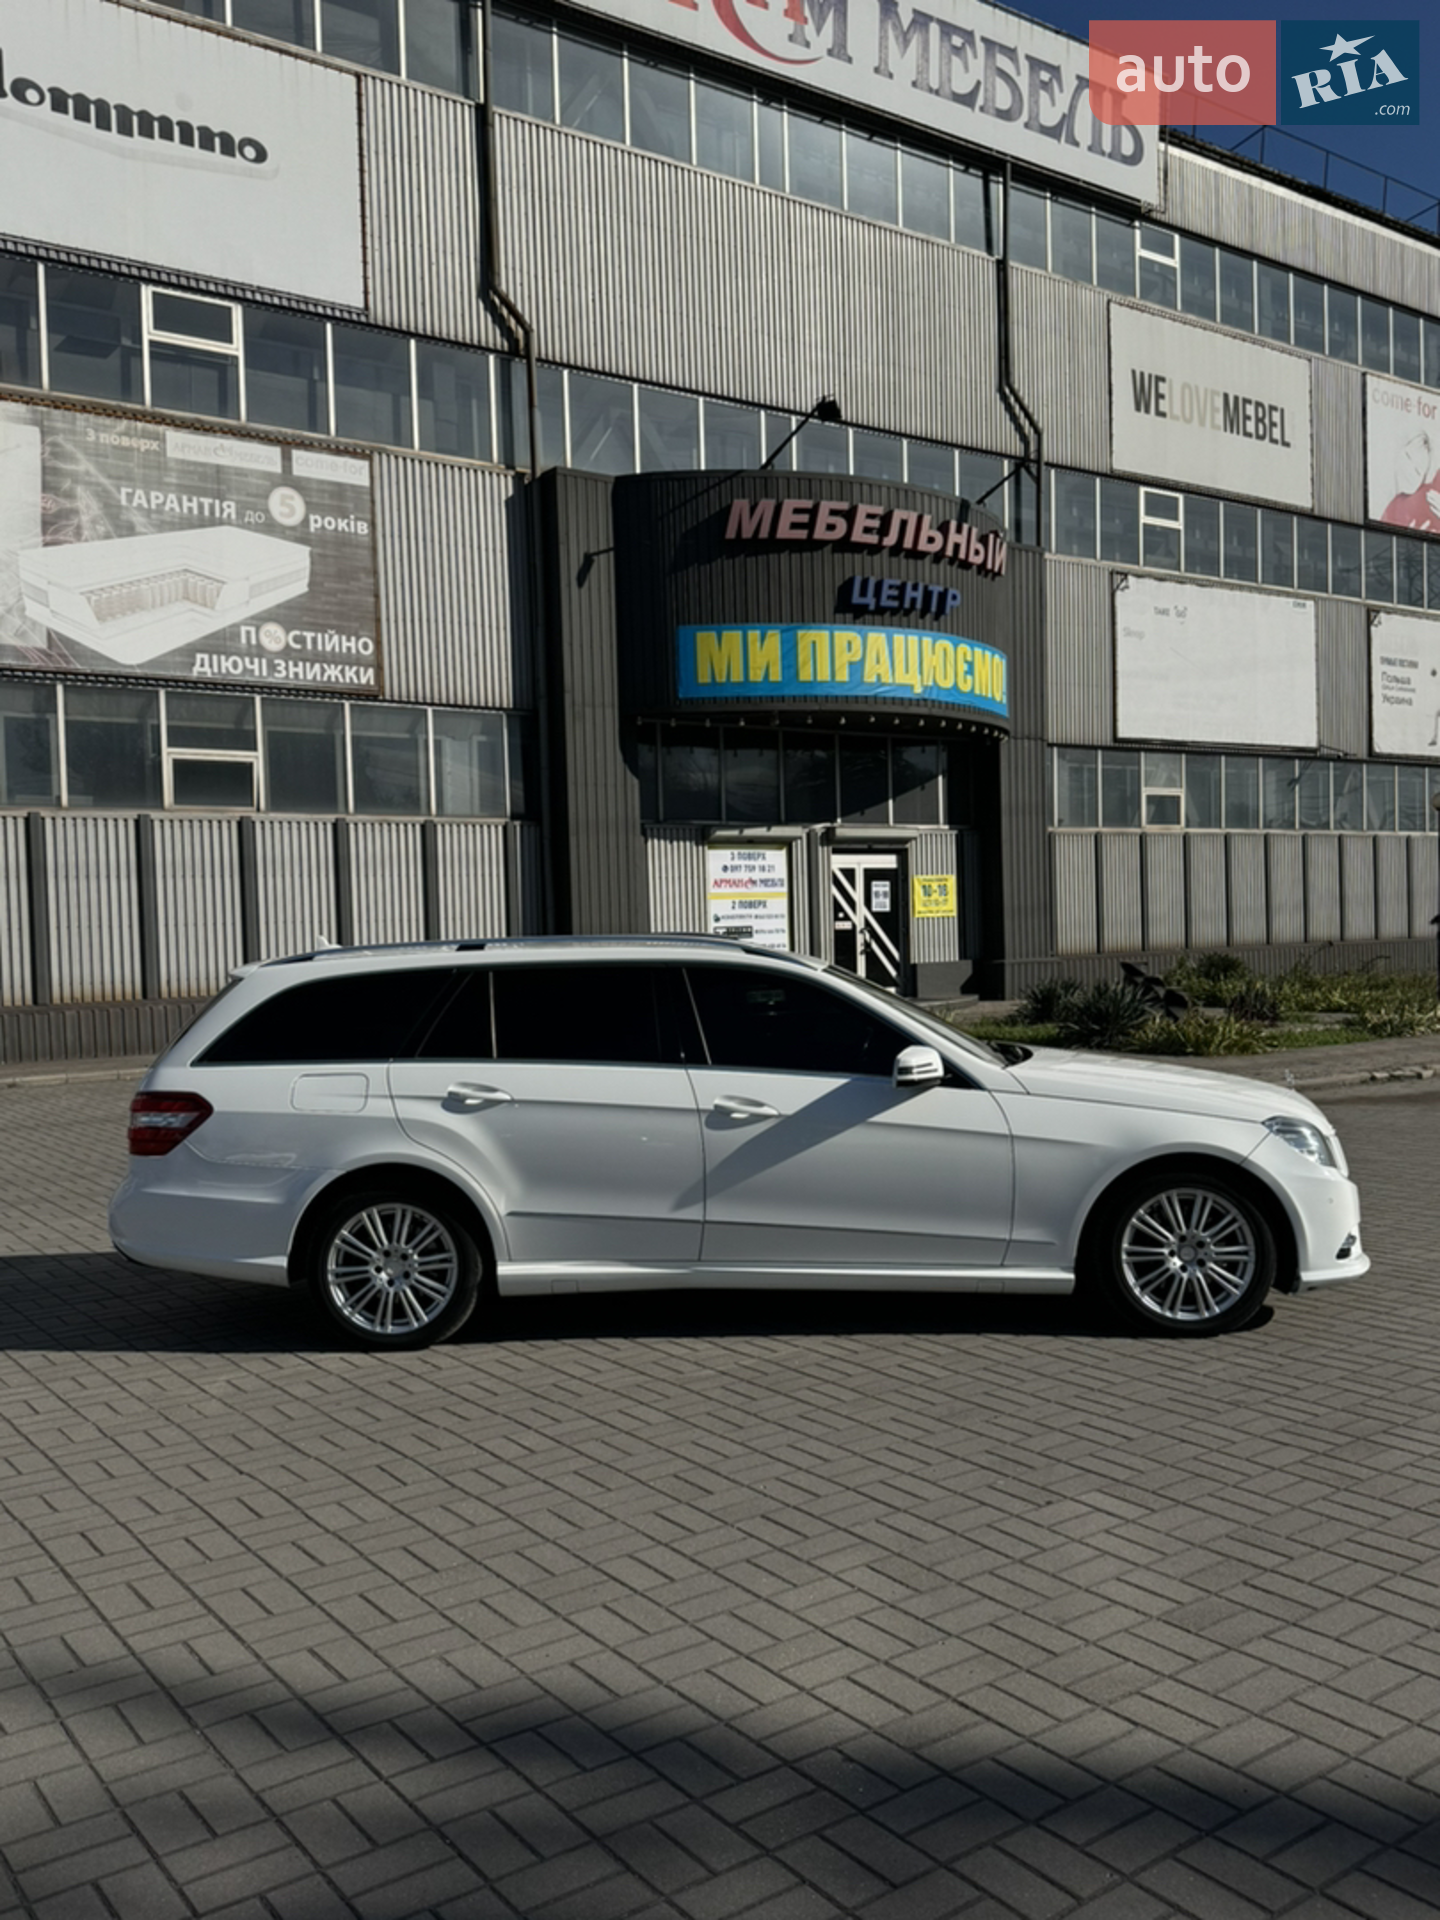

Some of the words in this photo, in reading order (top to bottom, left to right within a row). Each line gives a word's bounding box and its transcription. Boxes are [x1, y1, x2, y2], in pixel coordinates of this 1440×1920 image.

[0, 47, 268, 164] ommino
[873, 0, 1144, 167] МЕБЕЛЬ
[86, 428, 95, 441] 3
[98, 434, 160, 452] поверх
[120, 487, 237, 520] ГАРАНТІЯ
[244, 511, 266, 524] до
[278, 492, 296, 519] 5
[309, 513, 369, 535] років
[725, 499, 1007, 575] МЕБЕЛЬНЫЙ
[851, 575, 962, 616] ЦЕНТР
[192, 653, 267, 677] ДІЮЧІ
[273, 659, 375, 685] ЗНИЖКИ
[695, 630, 782, 684] МИ
[797, 630, 1007, 704] ПРАЦЮЄМО!
[738, 900, 768, 910] ПОВЕРХ
